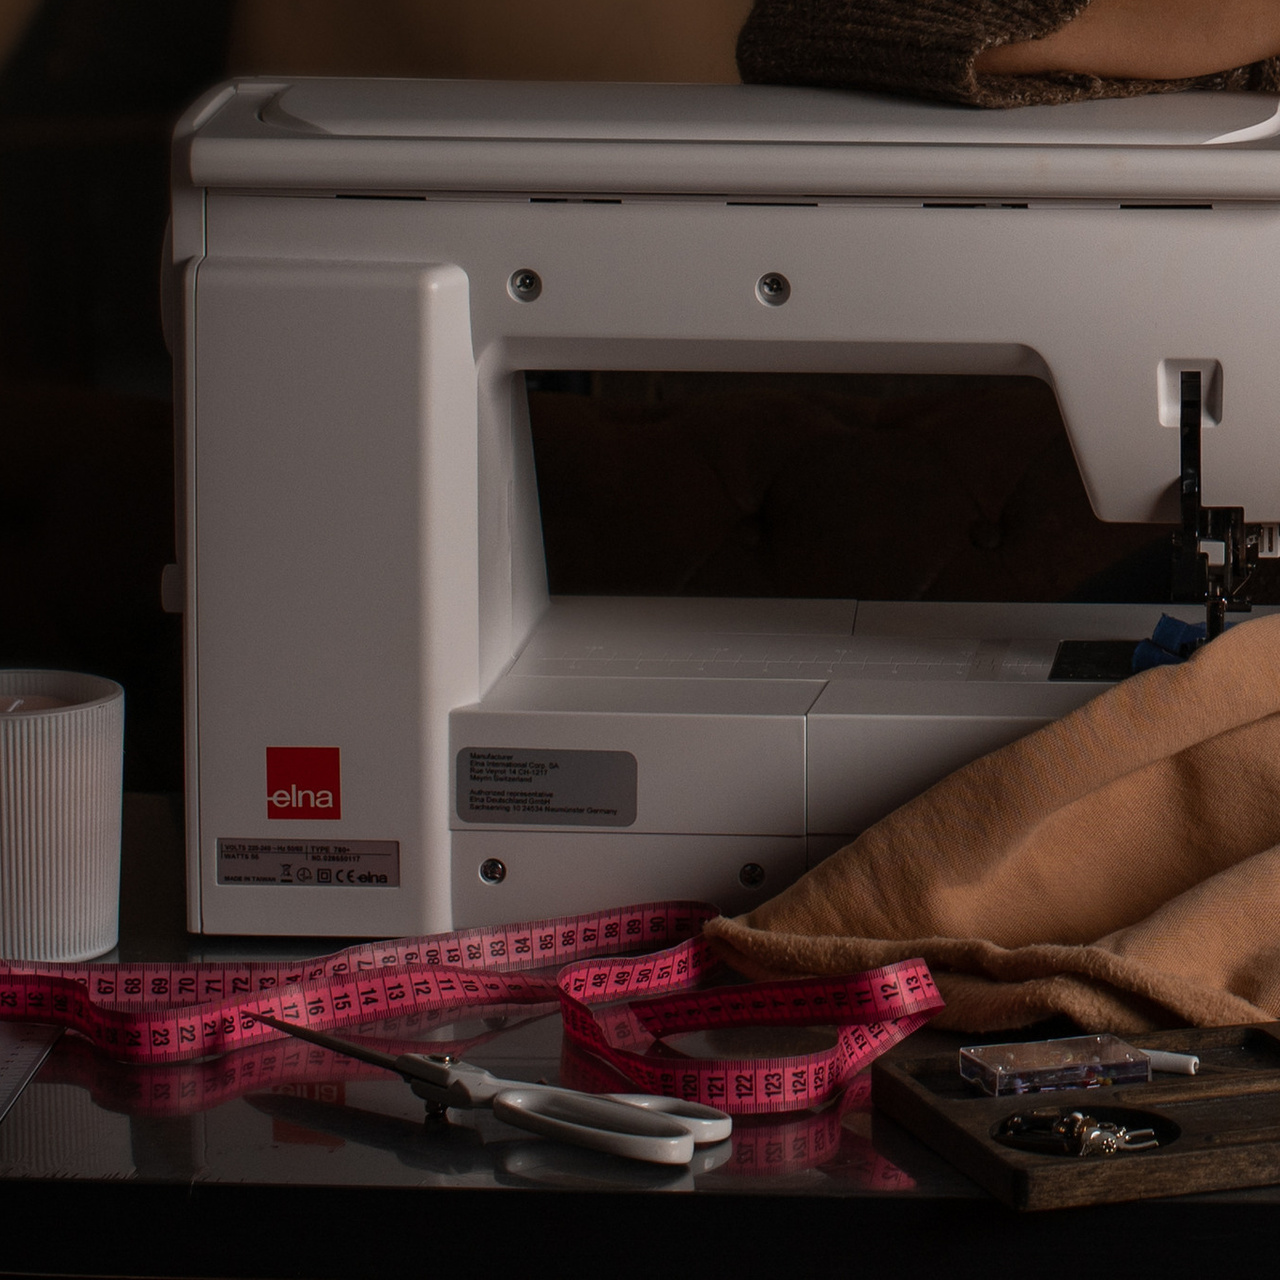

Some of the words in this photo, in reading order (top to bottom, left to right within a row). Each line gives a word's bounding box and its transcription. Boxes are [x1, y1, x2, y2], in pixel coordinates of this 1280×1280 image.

[470, 752, 513, 761] Manufacturer
[470, 760, 485, 768] Elna
[486, 761, 528, 769] International
[494, 775, 532, 783] Switzerland
[267, 783, 334, 808] elna
[469, 789, 505, 797] Authorized
[506, 790, 554, 799] representative
[469, 796, 485, 804] Elna
[486, 797, 527, 805] Deutschland
[586, 807, 618, 816] Germany
[357, 871, 388, 884] elna
[97, 978, 115, 995] 67
[124, 978, 141, 995] 68
[151, 977, 168, 995] 69
[178, 977, 195, 994] 70
[205, 978, 221, 994] 71
[232, 976, 249, 994] 72
[426, 949, 440, 965] 80
[446, 947, 460, 963] 81
[466, 943, 482, 960] 82
[490, 940, 506, 957] 83
[515, 937, 531, 954] 84
[539, 934, 554, 951] 85
[562, 929, 576, 946] 86
[583, 926, 597, 942] 87
[604, 922, 619, 938] 88
[626, 919, 641, 935] 89
[650, 916, 665, 933] 90
[573, 977, 585, 992] 47
[592, 972, 608, 988] 48
[614, 971, 630, 986] 49
[636, 968, 652, 983] 50
[657, 965, 672, 980] 51
[676, 957, 688, 975] 52
[832, 991, 848, 1007] 10
[855, 990, 872, 1006] 11
[881, 981, 899, 1001] 12
[906, 975, 921, 994] 13
[922, 973, 933, 988] 14
[0, 991, 18, 1007] 32
[28, 992, 44, 1007] 31
[126, 1030, 141, 1047] 24
[152, 1028, 170, 1047] 23
[179, 1025, 196, 1043] 22
[204, 1020, 217, 1037] 21
[223, 1015, 235, 1035] 20
[261, 1006, 276, 1019] 1
[283, 1002, 300, 1019] 17
[307, 997, 325, 1015] 16
[333, 992, 351, 1011] 15
[360, 987, 379, 1006] 14
[387, 982, 405, 1000] 13
[414, 979, 431, 996] 12
[439, 978, 456, 991] 11
[462, 979, 479, 992] 10
[682, 1074, 697, 1099] 120
[708, 1076, 725, 1099] 121
[735, 1074, 753, 1099] 122
[764, 1072, 782, 1098] 123
[792, 1069, 807, 1095] 124
[813, 1066, 824, 1091] 125
[850, 1027, 868, 1051] 131
[865, 1021, 885, 1039] 13
